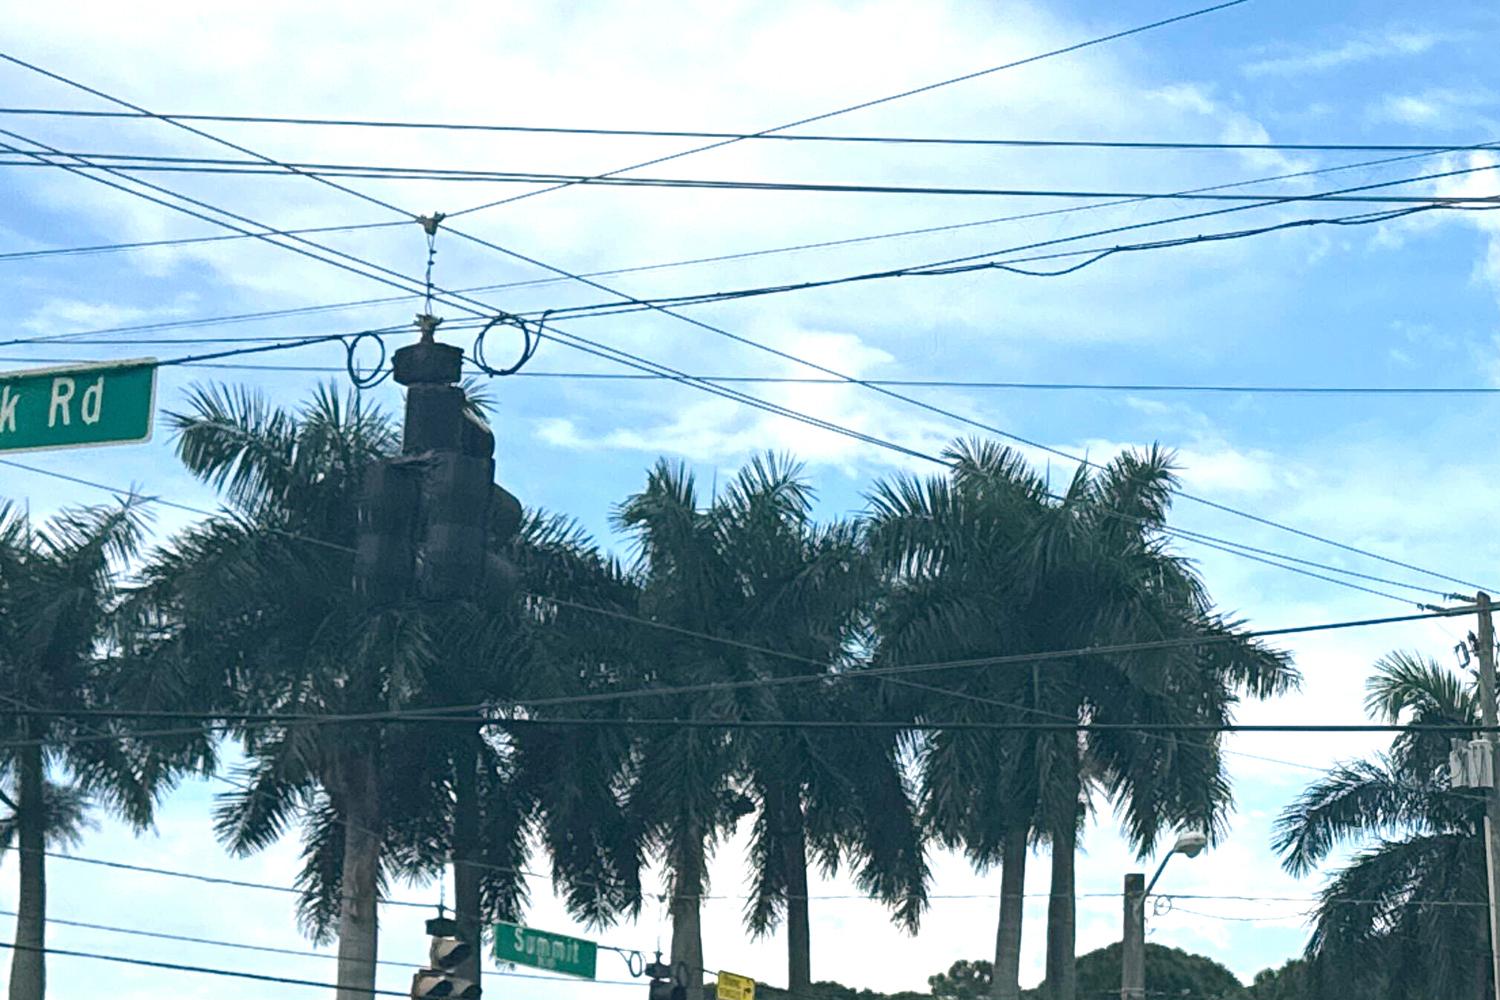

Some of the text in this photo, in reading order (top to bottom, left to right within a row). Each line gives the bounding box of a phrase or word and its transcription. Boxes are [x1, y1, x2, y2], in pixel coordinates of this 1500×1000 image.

[0, 375, 104, 433] k Rd
[513, 927, 580, 964] Summit
